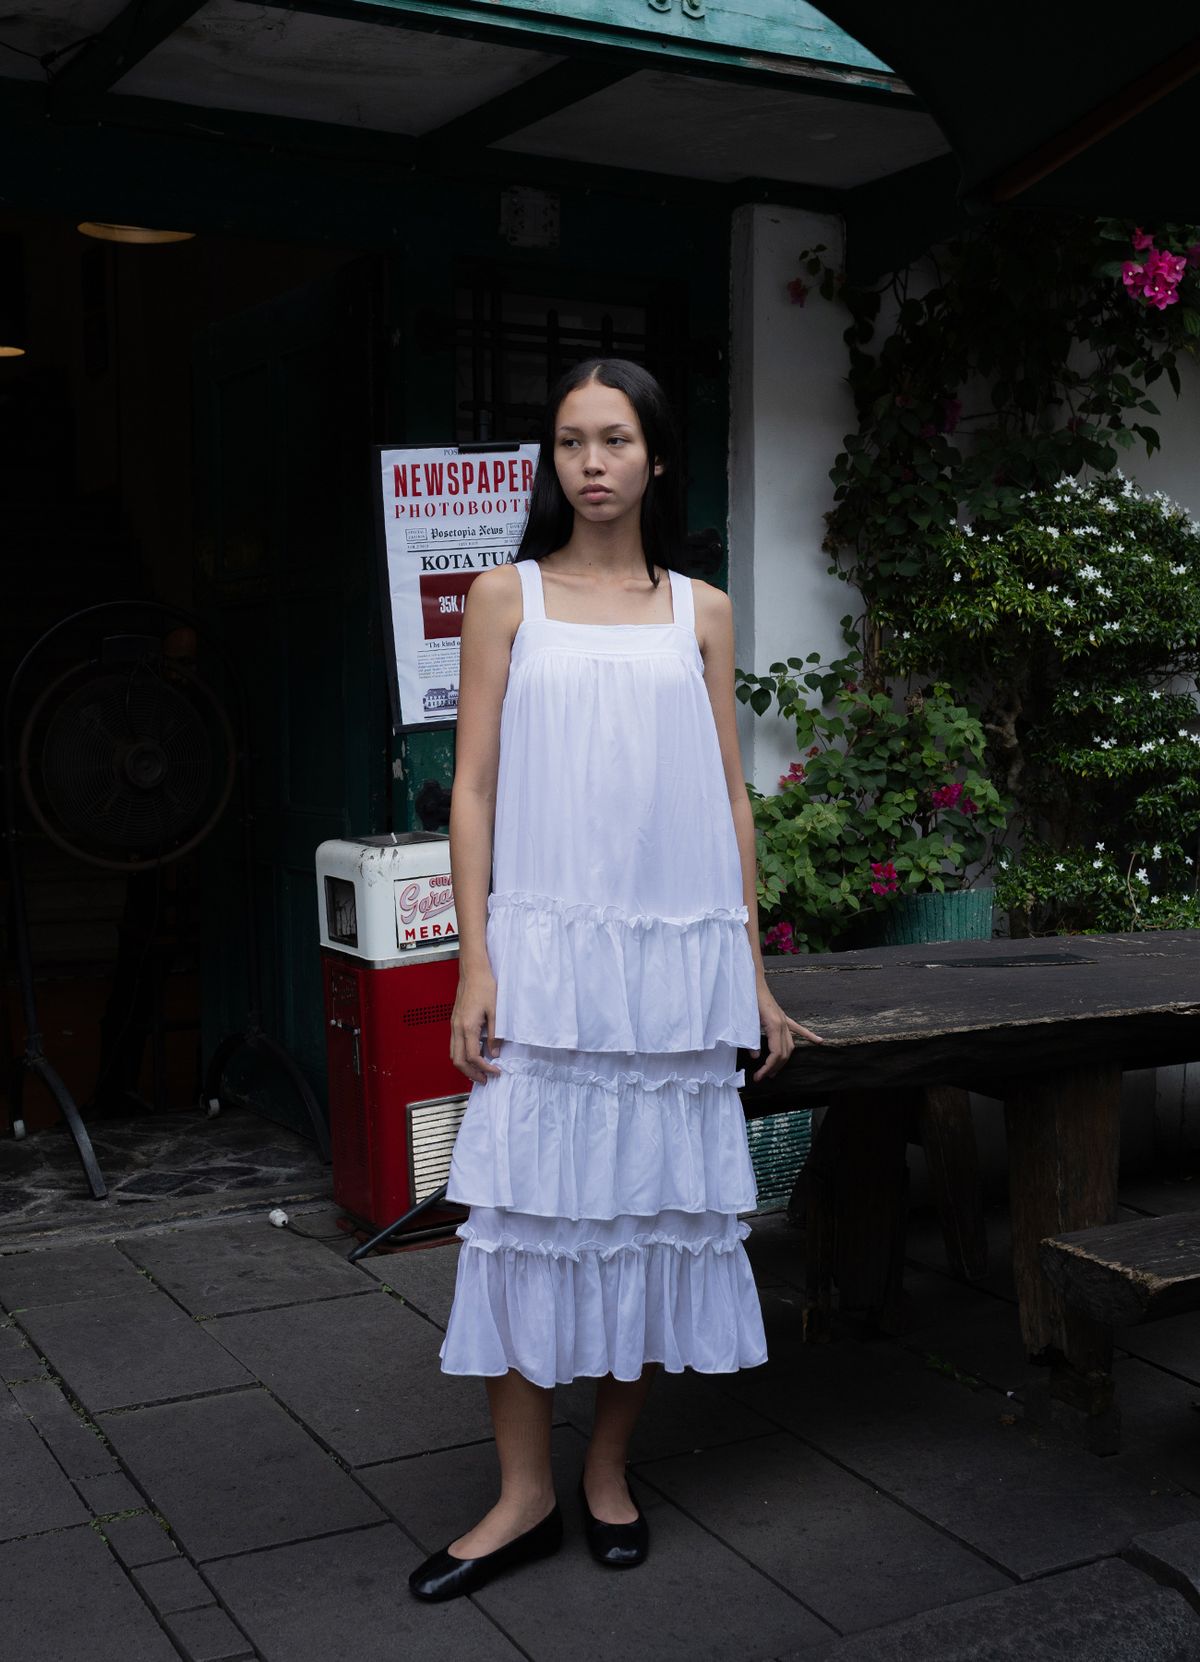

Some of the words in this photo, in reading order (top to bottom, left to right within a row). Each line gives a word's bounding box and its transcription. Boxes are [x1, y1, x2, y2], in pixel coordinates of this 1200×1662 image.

[393, 459, 534, 498] NEWSPAPER
[479, 524, 504, 536] News
[420, 554, 475, 571] KOTA
[438, 595, 459, 614] 35K
[441, 640, 456, 648] kind
[400, 883, 455, 925] Gara
[405, 922, 456, 941] MERA
